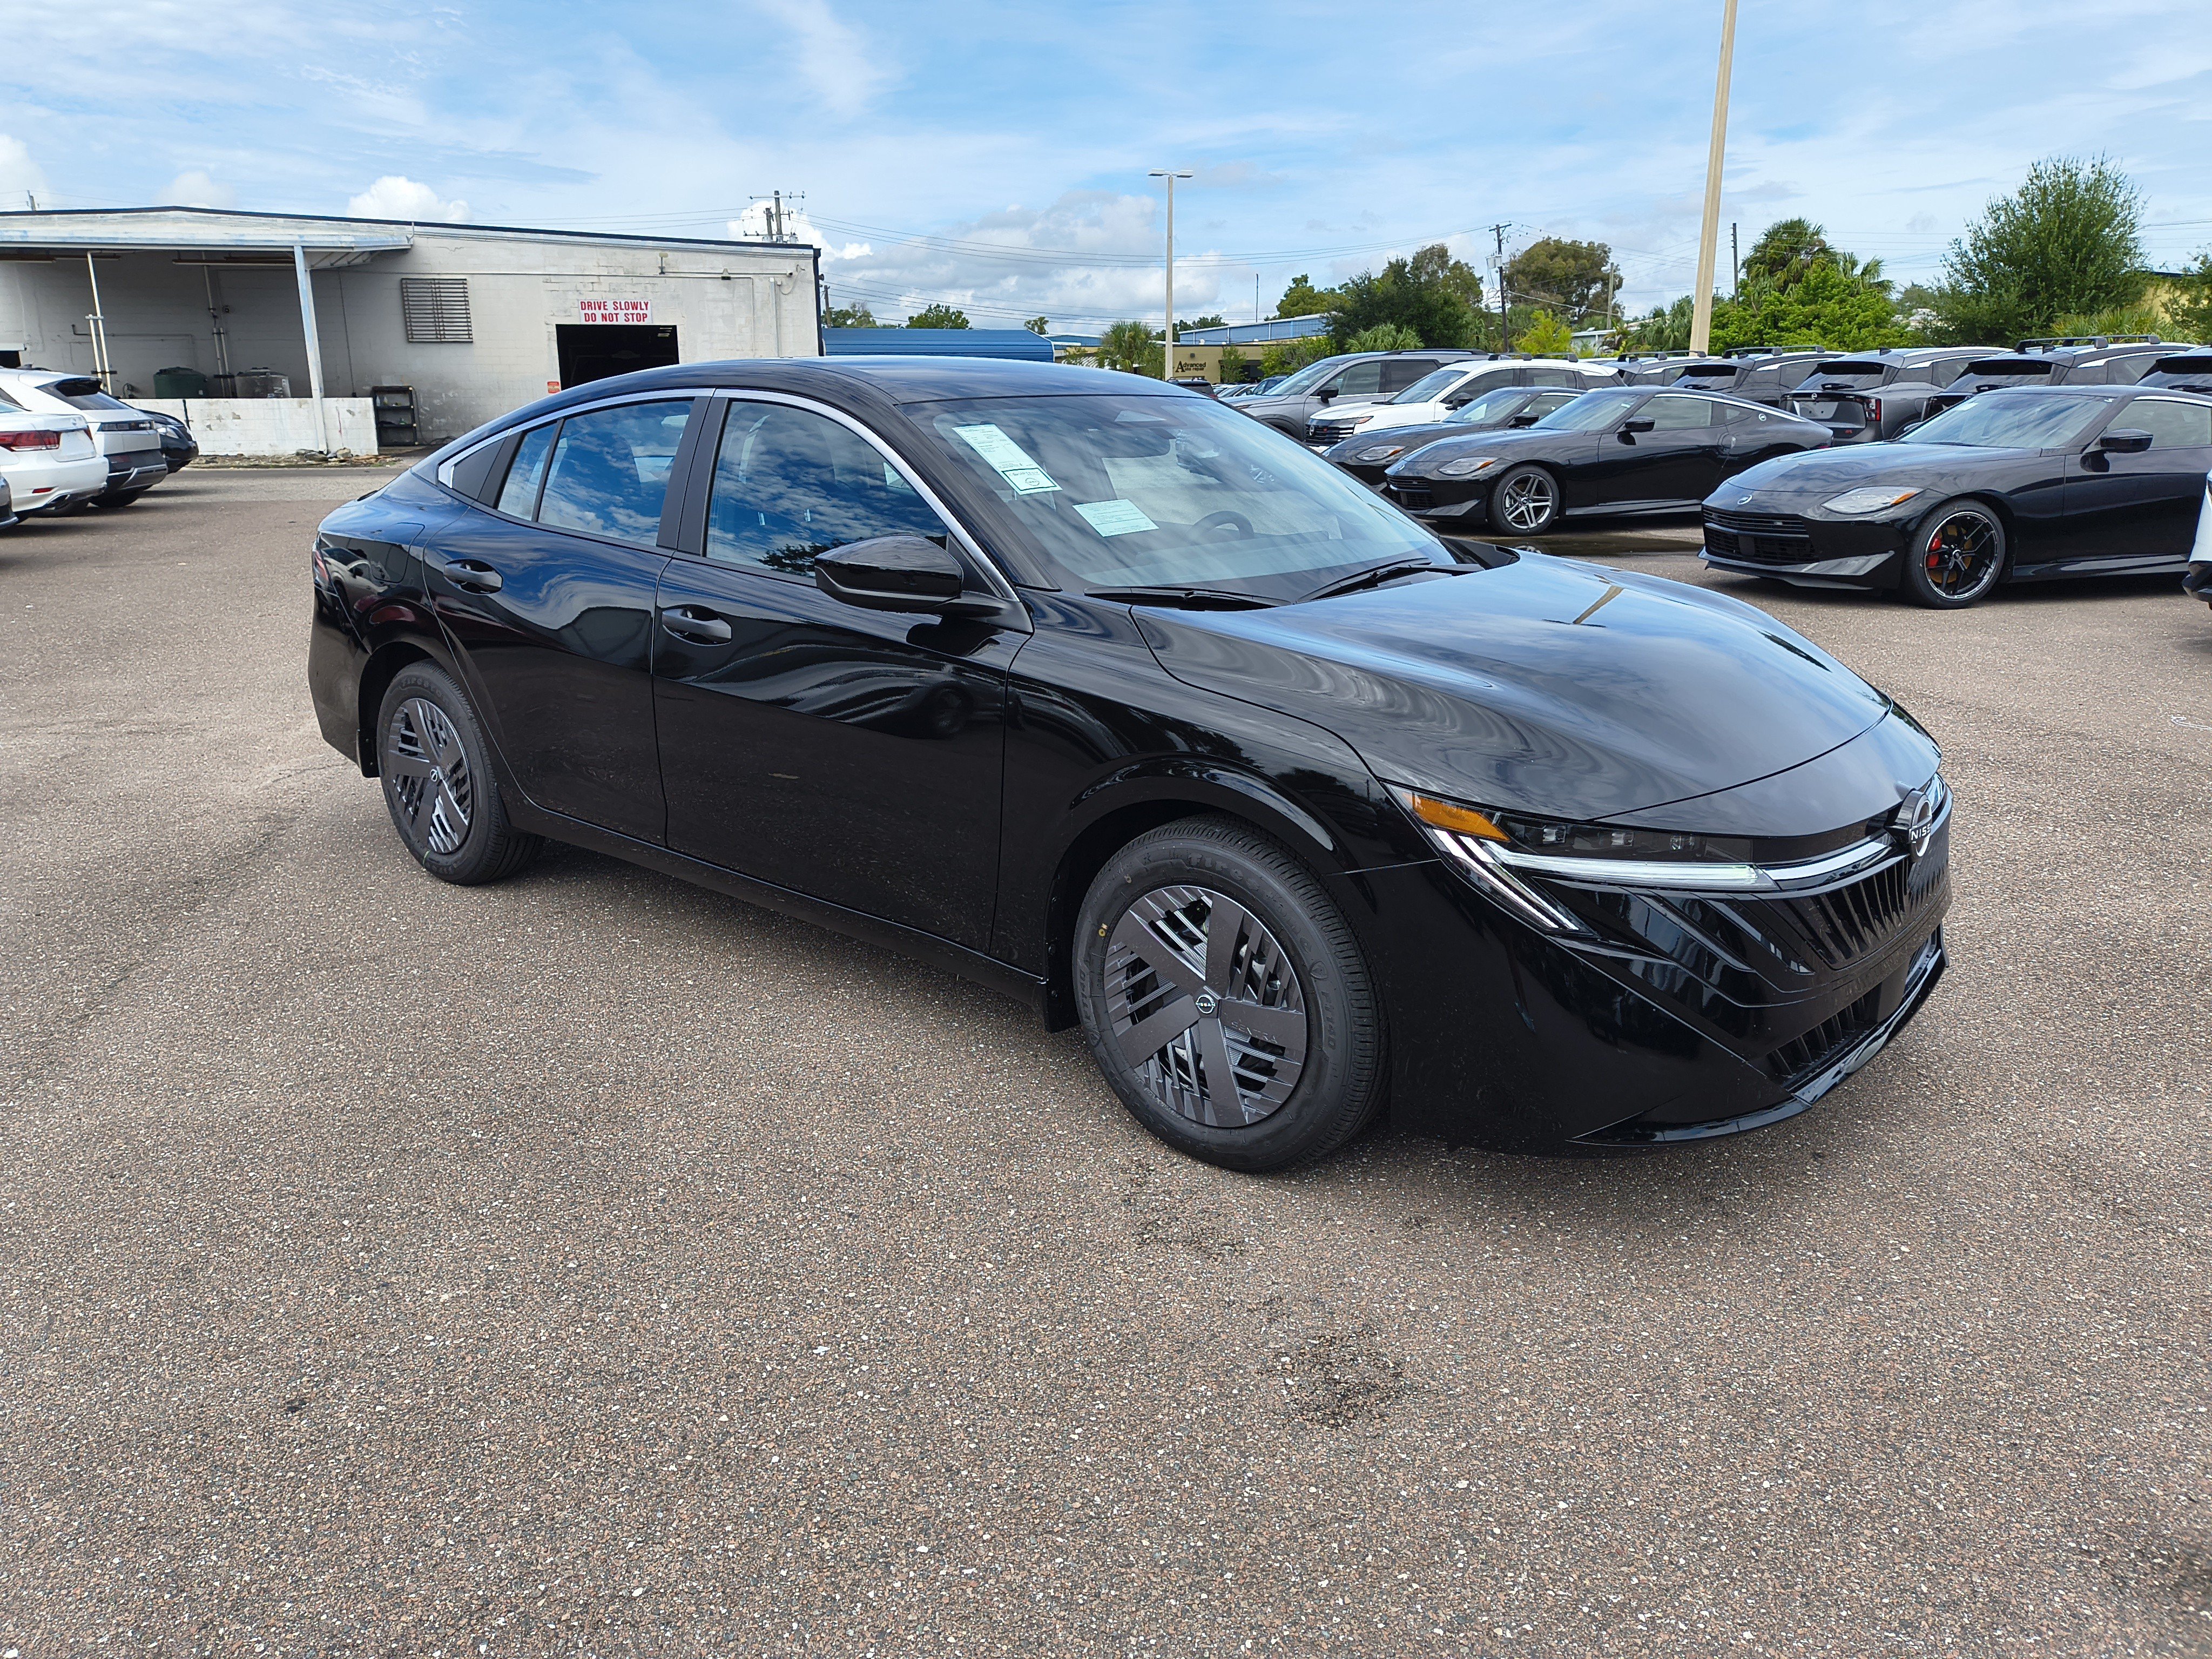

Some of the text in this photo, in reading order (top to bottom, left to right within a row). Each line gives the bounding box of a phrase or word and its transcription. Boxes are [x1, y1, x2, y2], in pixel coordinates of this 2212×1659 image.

[580, 301, 649, 311] DRIVE SLOWLY
[584, 313, 648, 322] DO NOT STOP
[1175, 361, 1206, 372] Advanced
[1911, 823, 1931, 841] NISS
